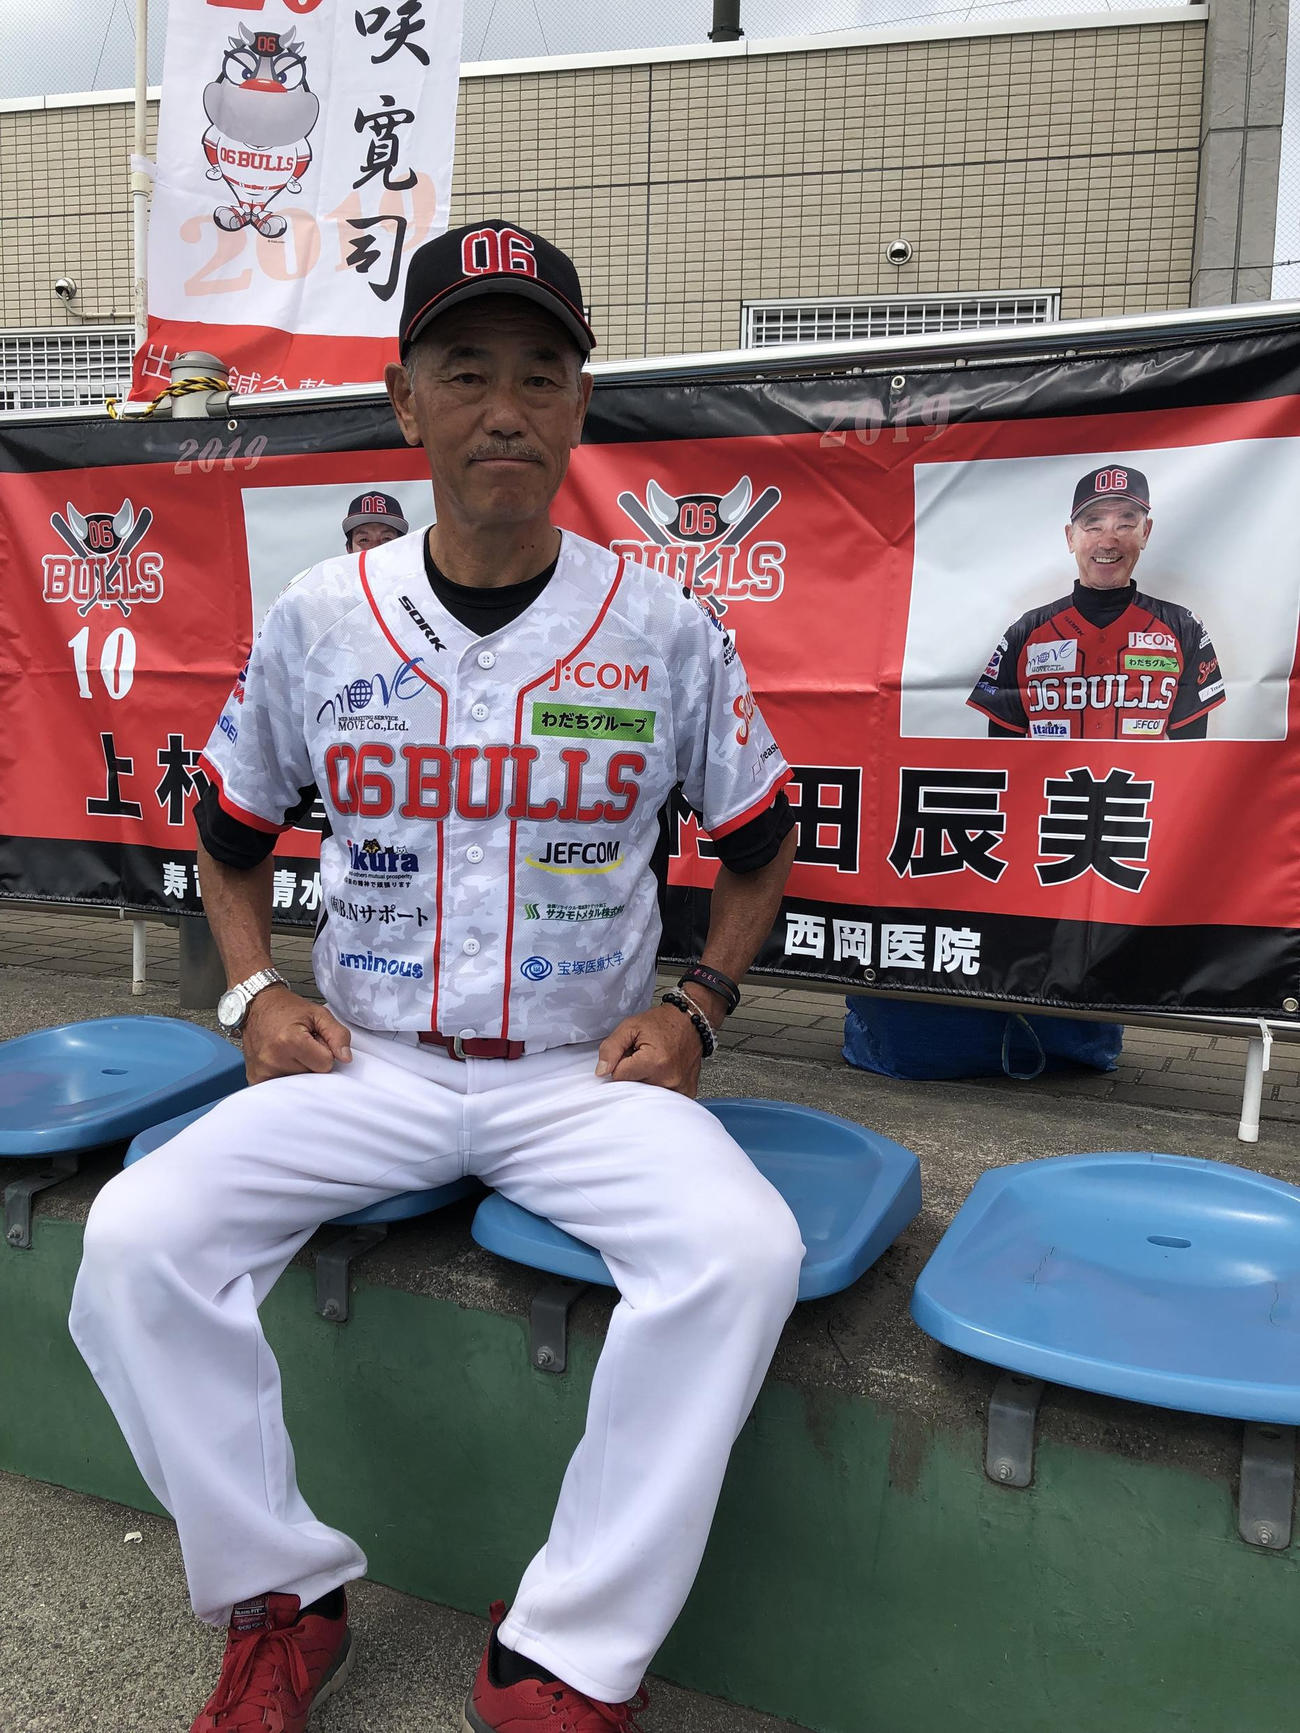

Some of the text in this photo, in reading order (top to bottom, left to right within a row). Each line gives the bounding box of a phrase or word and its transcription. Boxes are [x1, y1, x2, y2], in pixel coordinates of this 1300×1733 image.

[257, 36, 277, 52] 06
[461, 228, 537, 278] 06
[819, 393, 951, 448] 2019
[174, 434, 268, 475] 2019
[1095, 468, 1128, 493] 06
[361, 497, 387, 514] 06
[679, 502, 717, 536] 06
[88, 520, 115, 549] 06
[42, 552, 164, 603] BULLS
[398, 595, 447, 653] SORK
[68, 625, 136, 701] 10
[548, 658, 649, 693] J:COM
[338, 721, 365, 731] MOVE
[541, 709, 648, 734] わだちグループ
[539, 841, 620, 864] JEFCOM
[784, 911, 981, 976] 西岡医院
[558, 949, 625, 976] 宝塚医療大学
